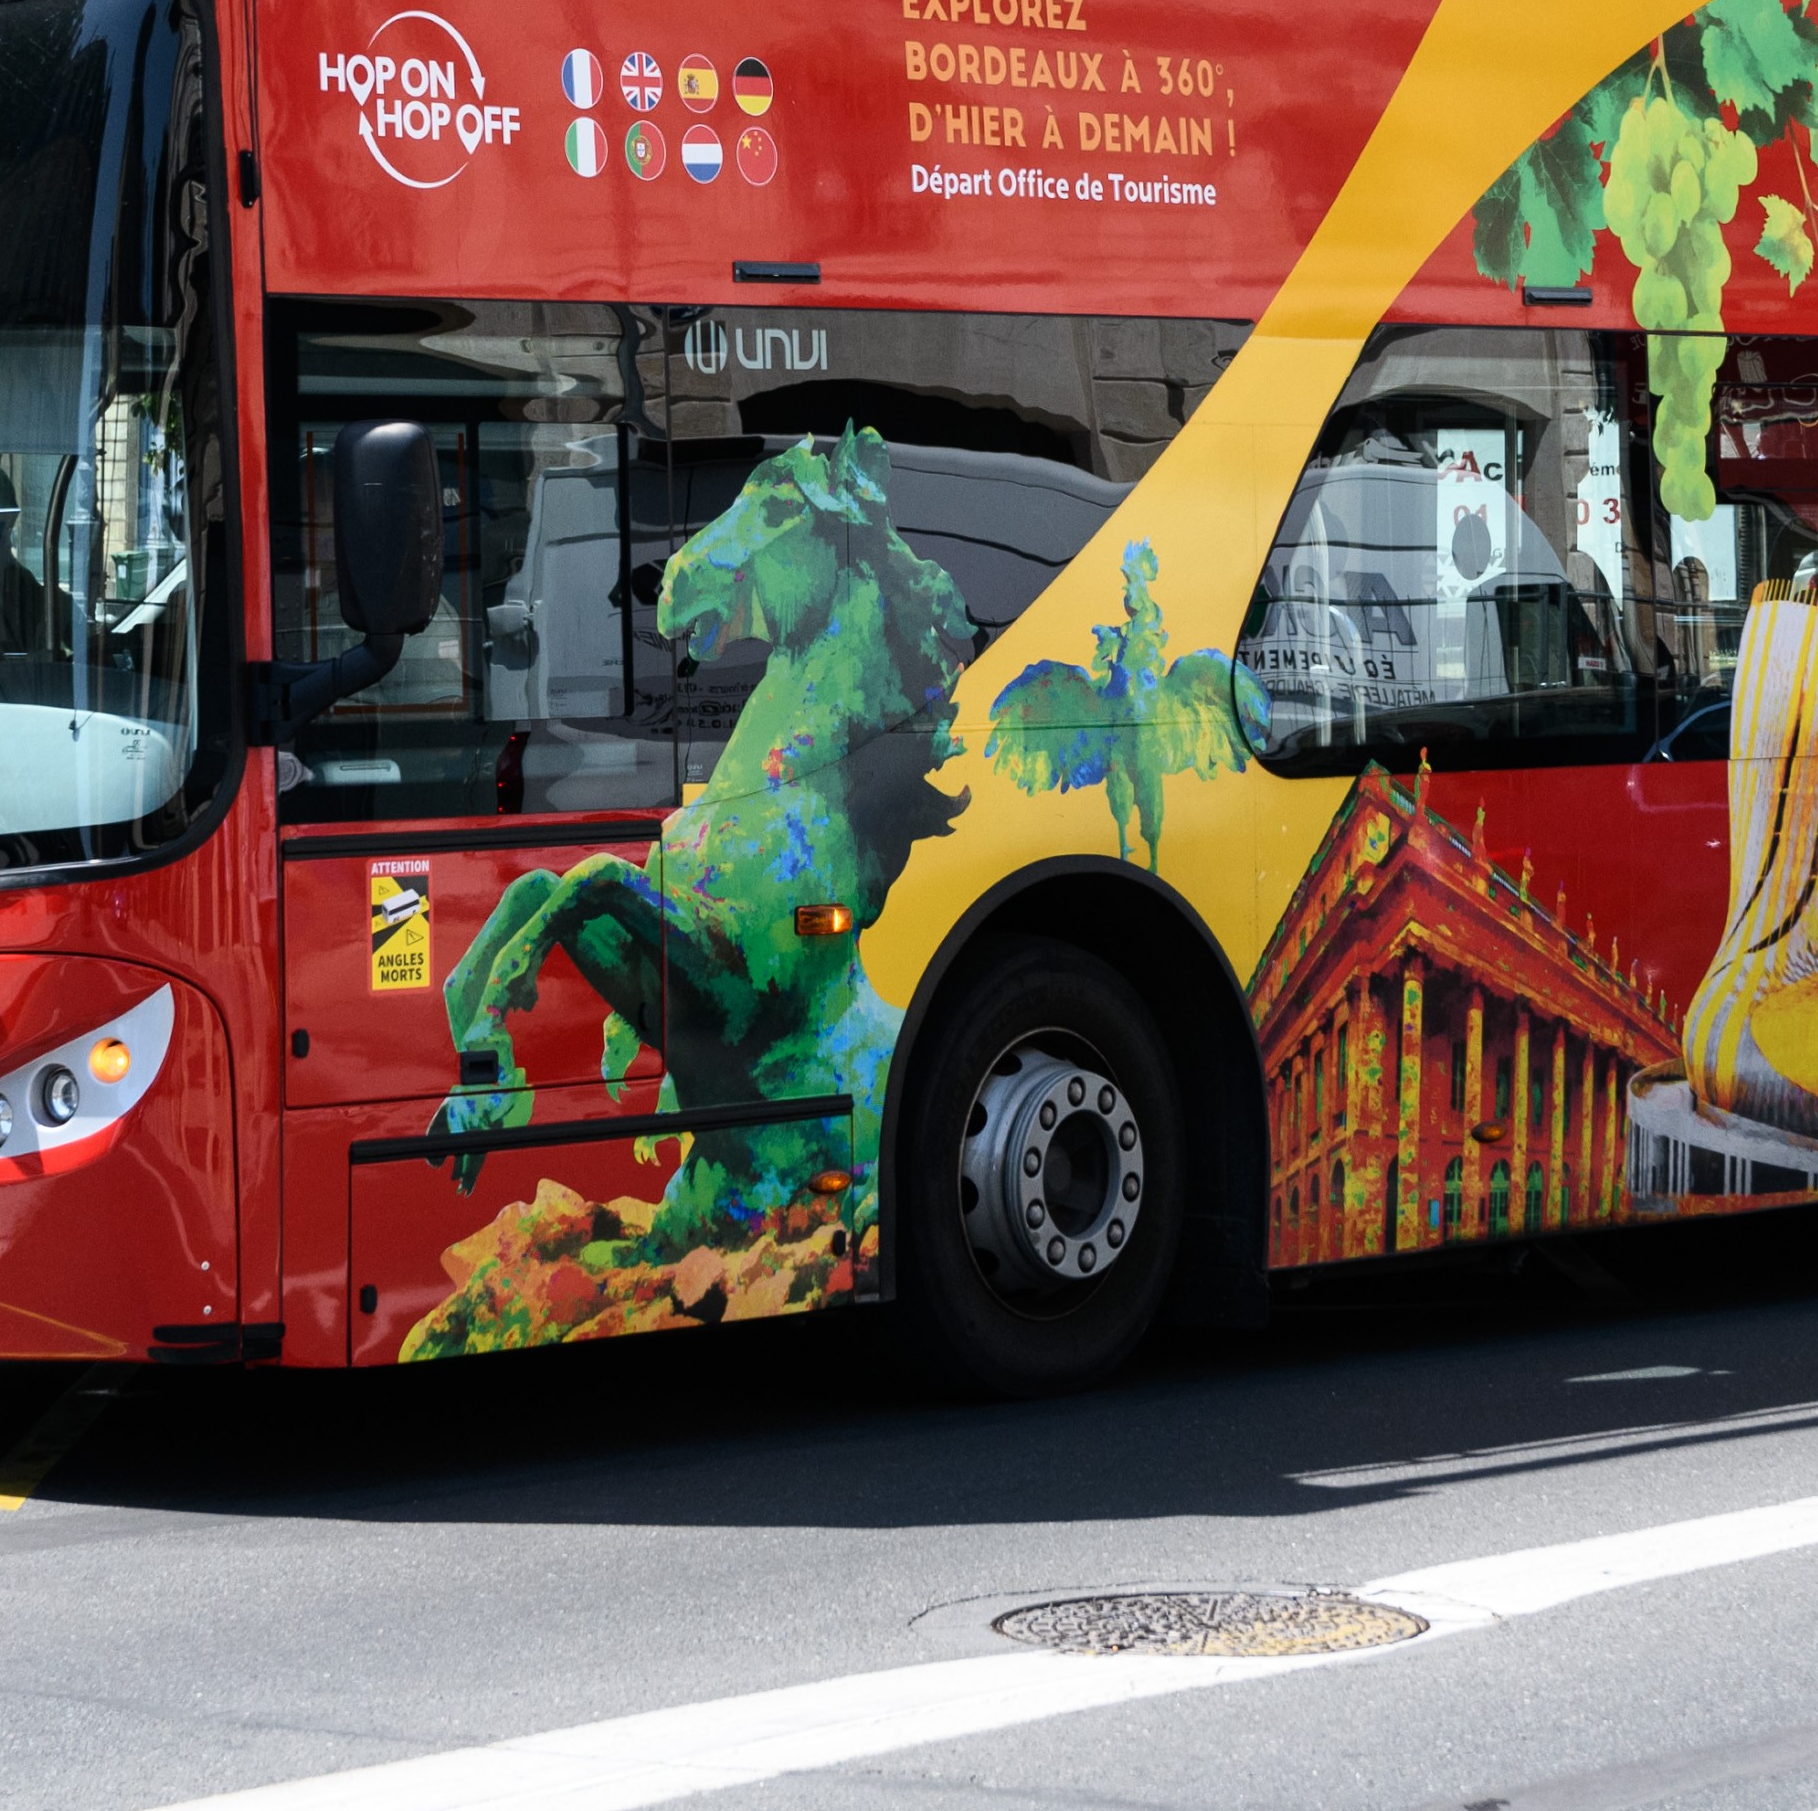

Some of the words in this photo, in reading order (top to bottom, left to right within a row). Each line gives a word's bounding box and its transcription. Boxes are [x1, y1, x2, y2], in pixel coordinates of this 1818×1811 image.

[319, 52, 396, 107] HOP
[401, 58, 456, 100] ON
[905, 40, 1106, 92] BORDEAUX
[1120, 49, 1142, 94] À
[376, 98, 451, 140] HOP
[456, 104, 521, 155] OFF
[908, 102, 1027, 148] D'HIER
[1042, 105, 1065, 150] À
[1079, 112, 1213, 156] DEMAIN
[911, 163, 993, 199] Départ
[997, 167, 1069, 200] Office
[1075, 171, 1103, 201] de
[1108, 174, 1217, 205] Tourisme
[371, 860, 430, 876] ATTENTION
[378, 952, 424, 967] ANGLES
[380, 967, 422, 983] MORTS
